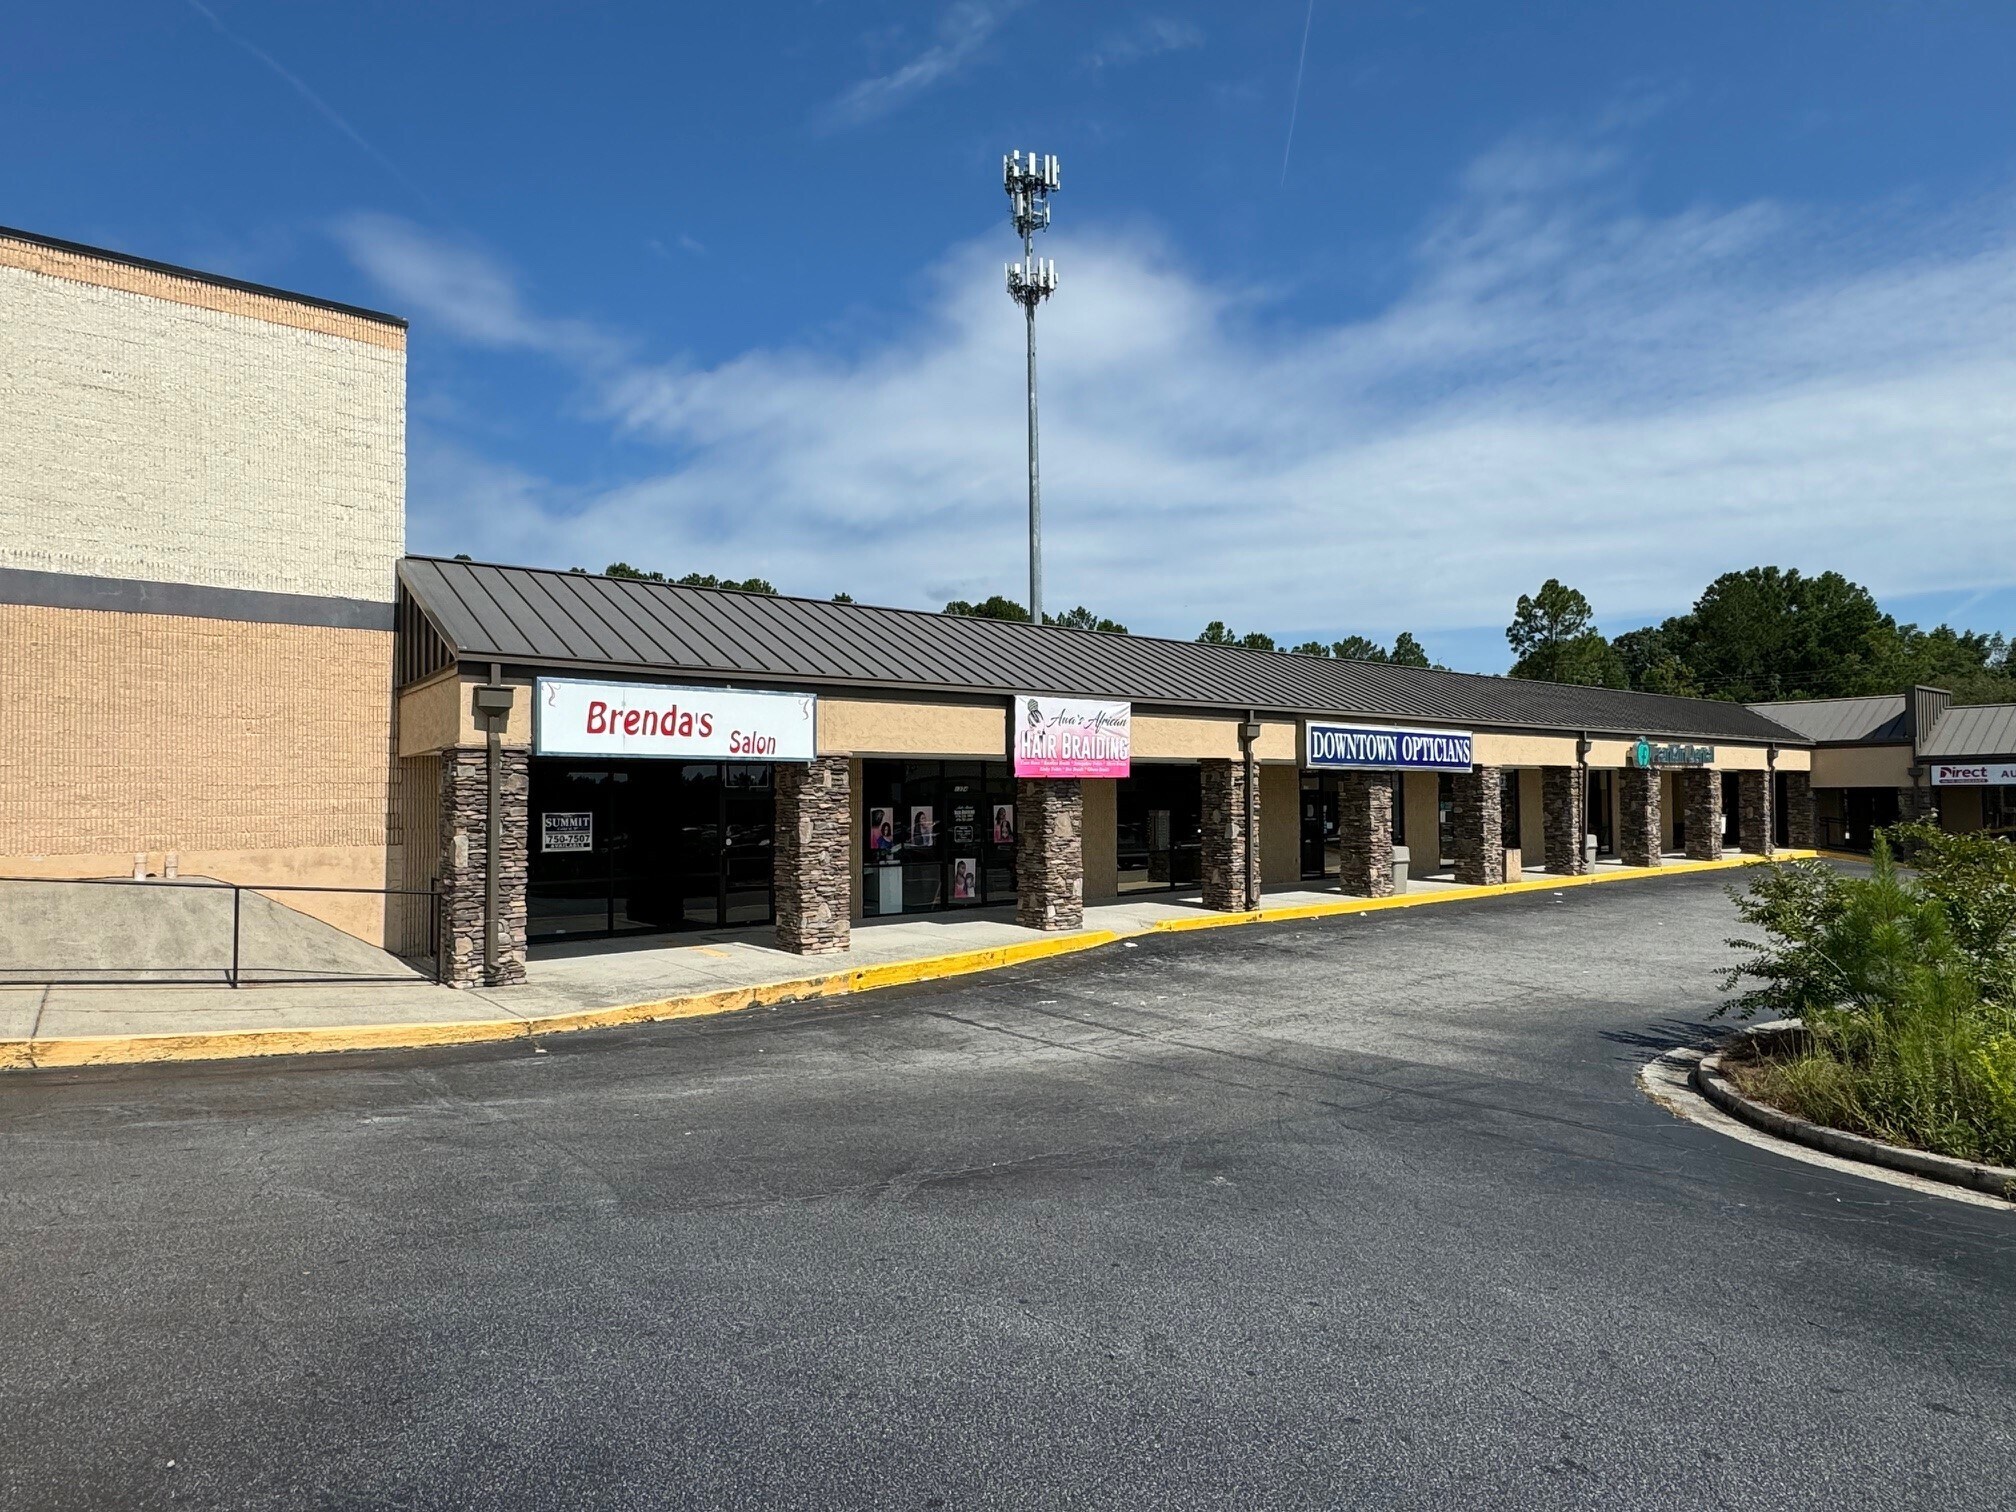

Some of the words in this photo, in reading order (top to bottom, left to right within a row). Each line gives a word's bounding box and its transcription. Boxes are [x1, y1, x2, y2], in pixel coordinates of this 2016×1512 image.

[586, 701, 713, 738] Brenda's
[729, 730, 776, 755] Salon
[1084, 710, 1127, 734] African
[1020, 730, 1057, 759] HAIR
[1062, 732, 1129, 760] BRAIDING
[1312, 731, 1398, 761] DOWNTOWN
[1402, 736, 1470, 763] OPTICIANS
[1940, 766, 1988, 778] Direct
[545, 817, 590, 828] SUMMIT
[548, 835, 590, 843] 750-7507
